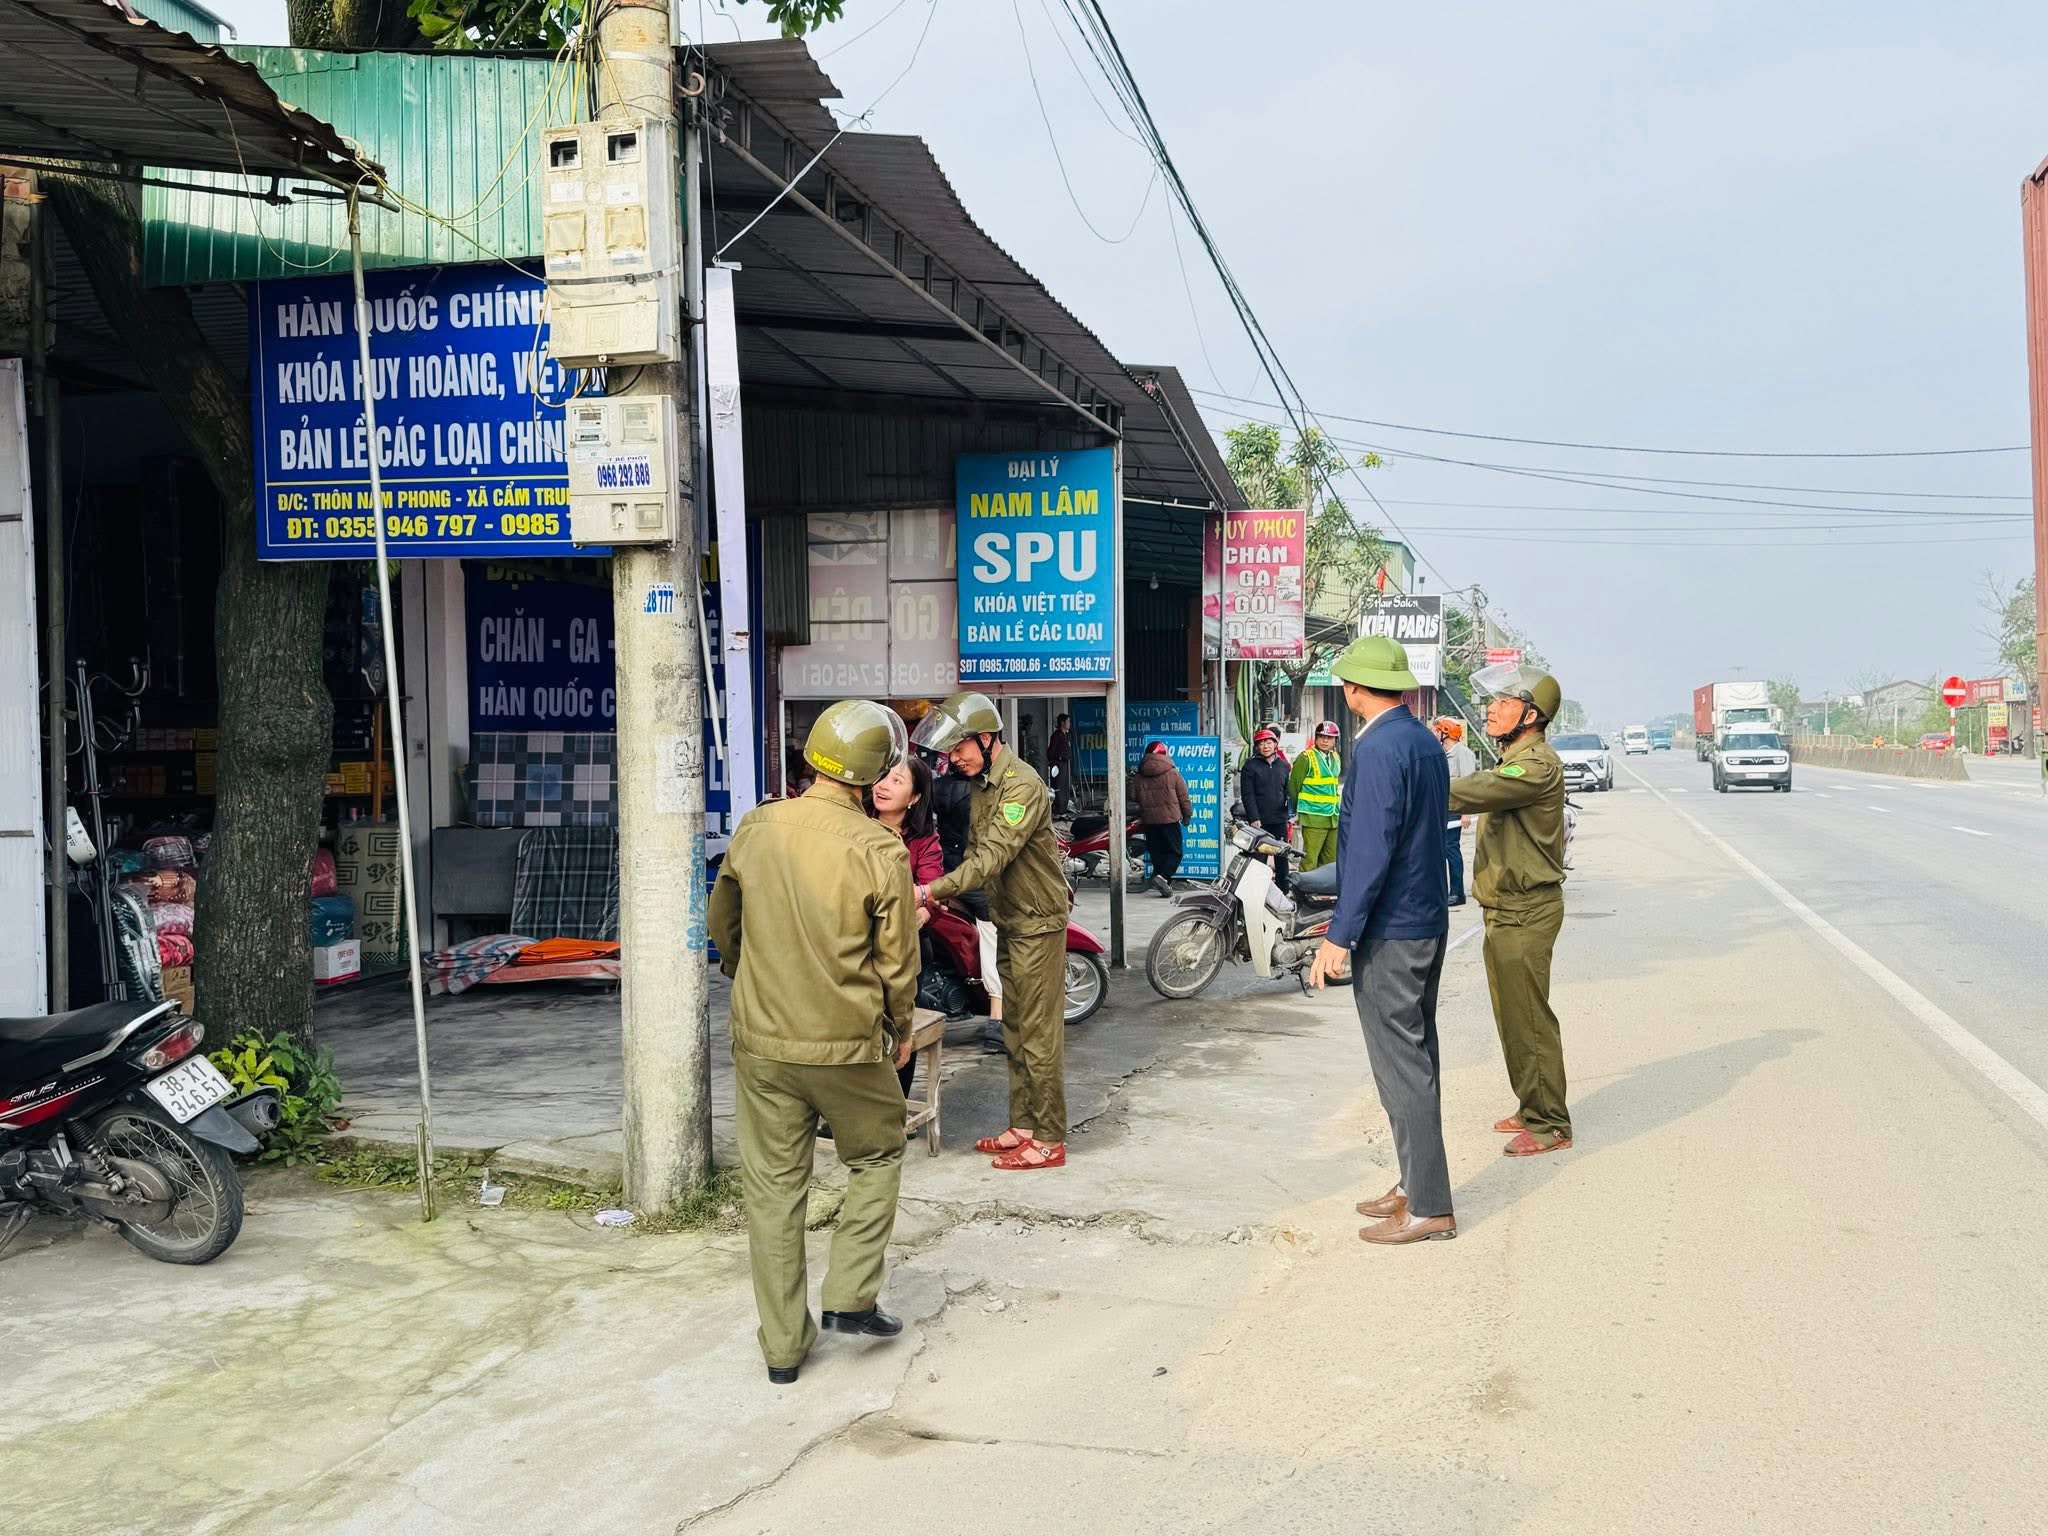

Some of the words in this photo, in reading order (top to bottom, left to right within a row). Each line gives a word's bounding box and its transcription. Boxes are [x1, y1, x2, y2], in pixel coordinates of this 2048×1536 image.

[278, 296, 343, 338] HÀN
[354, 284, 438, 337] QUỐC
[278, 352, 346, 404] KHÓA
[409, 345, 505, 401] HOÀNG,
[280, 415, 332, 471] BẢN
[377, 416, 426, 468] CÁC
[434, 422, 491, 475] LOẠI
[500, 410, 568, 465] CHÍN
[597, 464, 618, 488] 0968
[619, 463, 634, 487] 292
[635, 462, 651, 486] 888
[1008, 460, 1036, 482] ĐẠI
[1040, 455, 1060, 477] LÝ
[278, 493, 308, 511] Đ/C:
[312, 488, 352, 510] THÔN
[398, 489, 451, 508] PHONG
[467, 485, 489, 508] XÃ
[534, 486, 571, 507] TRU
[970, 492, 1032, 519] NAM
[1042, 485, 1099, 517] LÂM
[287, 518, 319, 538] ĐT:
[326, 517, 377, 537] 0355
[387, 516, 428, 537] 946
[435, 515, 478, 536] 797
[501, 513, 560, 536] 0985
[1253, 516, 1296, 540] PHÚC
[973, 530, 1097, 584] SPU
[1224, 544, 1288, 564] CHĂN
[1239, 569, 1271, 588] GA
[658, 590, 674, 613] 777
[974, 592, 1018, 613] KHÓA
[1022, 591, 1056, 616] VIỆT
[1061, 589, 1096, 616] TIỆP
[1234, 588, 1276, 614] GỐI
[480, 607, 545, 663] CHĂN
[569, 617, 600, 664] GA
[1029, 620, 1062, 642] CÁC
[1067, 622, 1103, 644] LOẠI
[1226, 617, 1283, 644] ĐỆM
[1396, 613, 1440, 639] PARIS
[960, 659, 977, 673] SĐT
[979, 657, 1041, 673] 0985.7080.66
[1050, 656, 1111, 672] 0355.946.797
[480, 680, 525, 716] HÀN
[533, 677, 593, 720] QUỐC
[1177, 743, 1217, 758] NGUYÊN
[160, 1061, 207, 1097] 38-X1
[171, 1076, 227, 1117] 346.51
